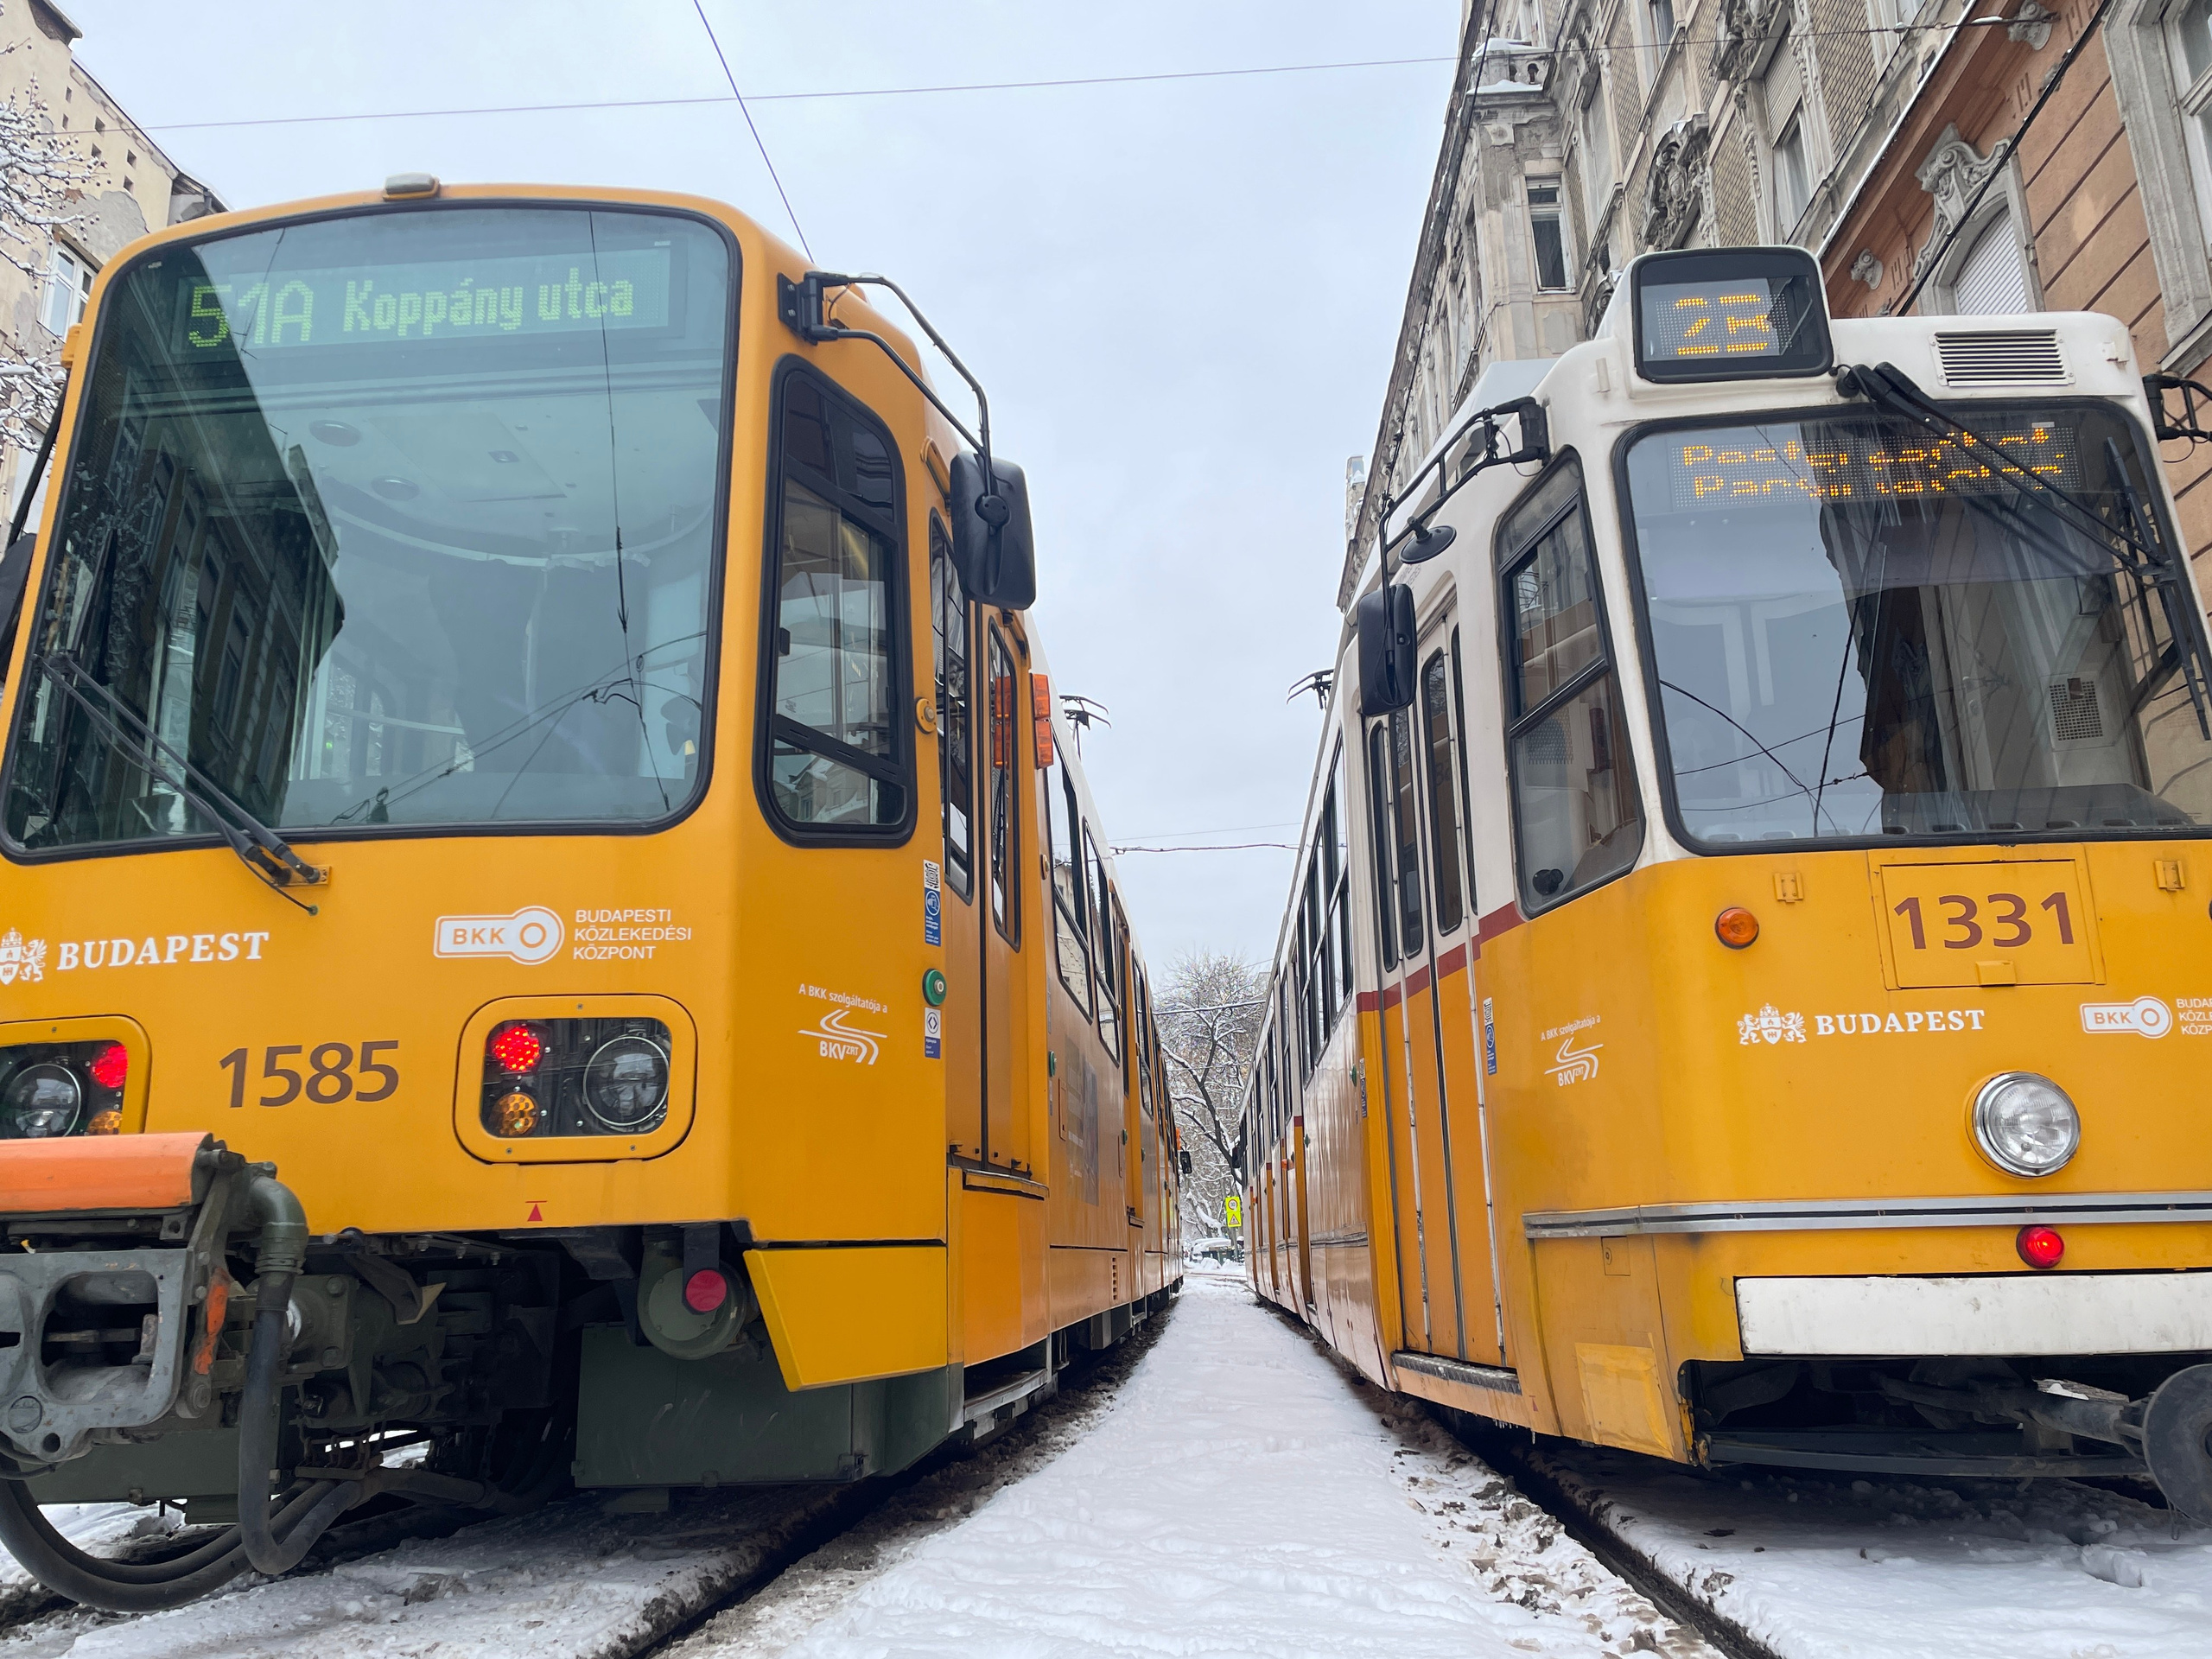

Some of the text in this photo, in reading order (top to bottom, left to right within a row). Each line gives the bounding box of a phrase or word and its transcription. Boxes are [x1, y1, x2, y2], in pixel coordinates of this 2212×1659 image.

[188, 267, 633, 347] 51A Koppány utca
[575, 909, 672, 923] BUDAPESTI
[1893, 892, 2075, 950] 1331
[452, 927, 505, 945] BKK
[574, 925, 692, 941] KÖZLEKEDÉSI
[56, 931, 270, 970] BUDAPEST
[573, 943, 657, 959] KÖZPONT
[798, 983, 888, 1014] A BKK szolgáltatója a
[1541, 1032, 1547, 1042] A
[1546, 1027, 1559, 1040] BKK
[1596, 1014, 1601, 1023] a
[1815, 1009, 1986, 1035] BUDAPEST
[2094, 1012, 2132, 1024] BKK
[219, 1039, 399, 1109] 1585
